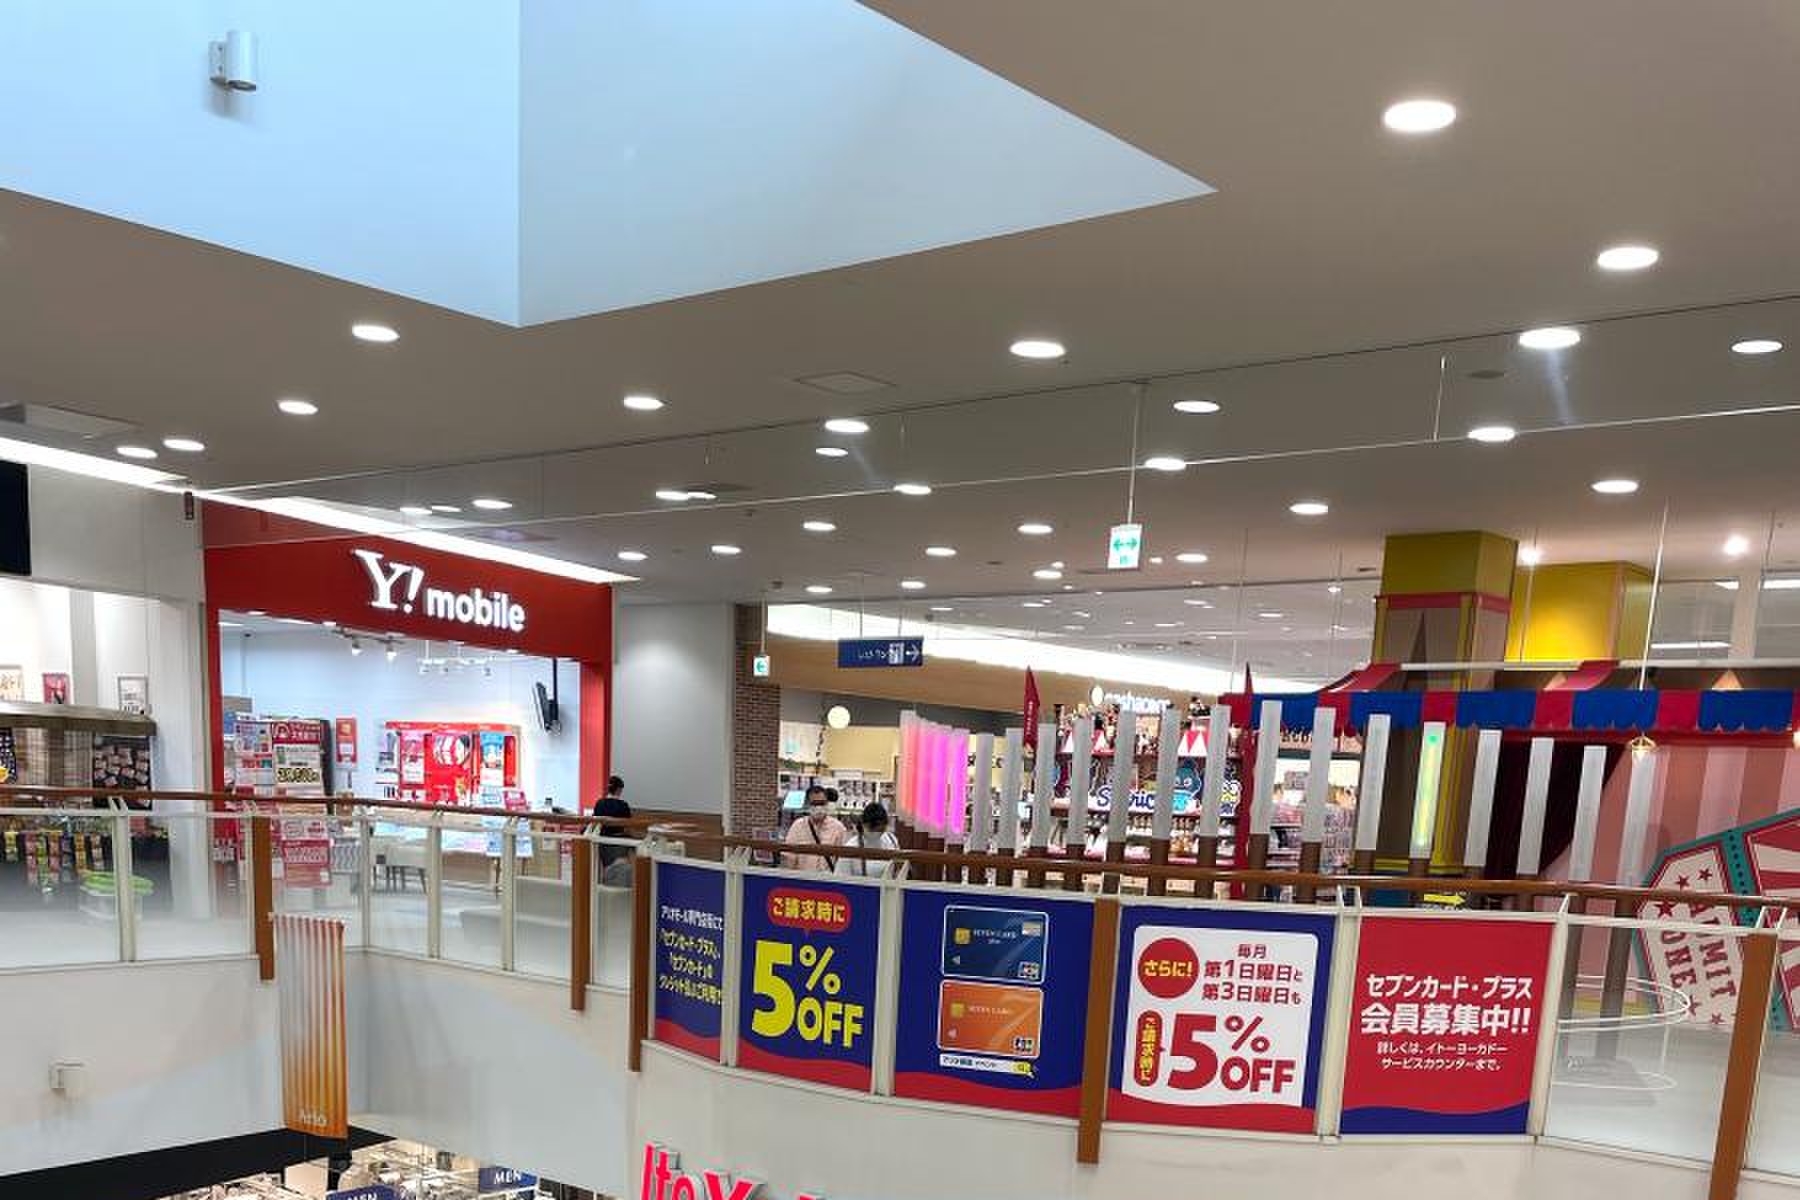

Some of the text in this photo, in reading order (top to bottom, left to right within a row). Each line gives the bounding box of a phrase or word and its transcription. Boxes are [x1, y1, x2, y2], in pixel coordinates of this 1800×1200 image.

[772, 897, 846, 922] ご請求時に
[1237, 943, 1266, 959] 毎月
[1204, 960, 1303, 982] 第1日曜日と
[1201, 982, 1303, 1005] 第3日曜日も
[1366, 974, 1533, 999] セブンカード・プラス
